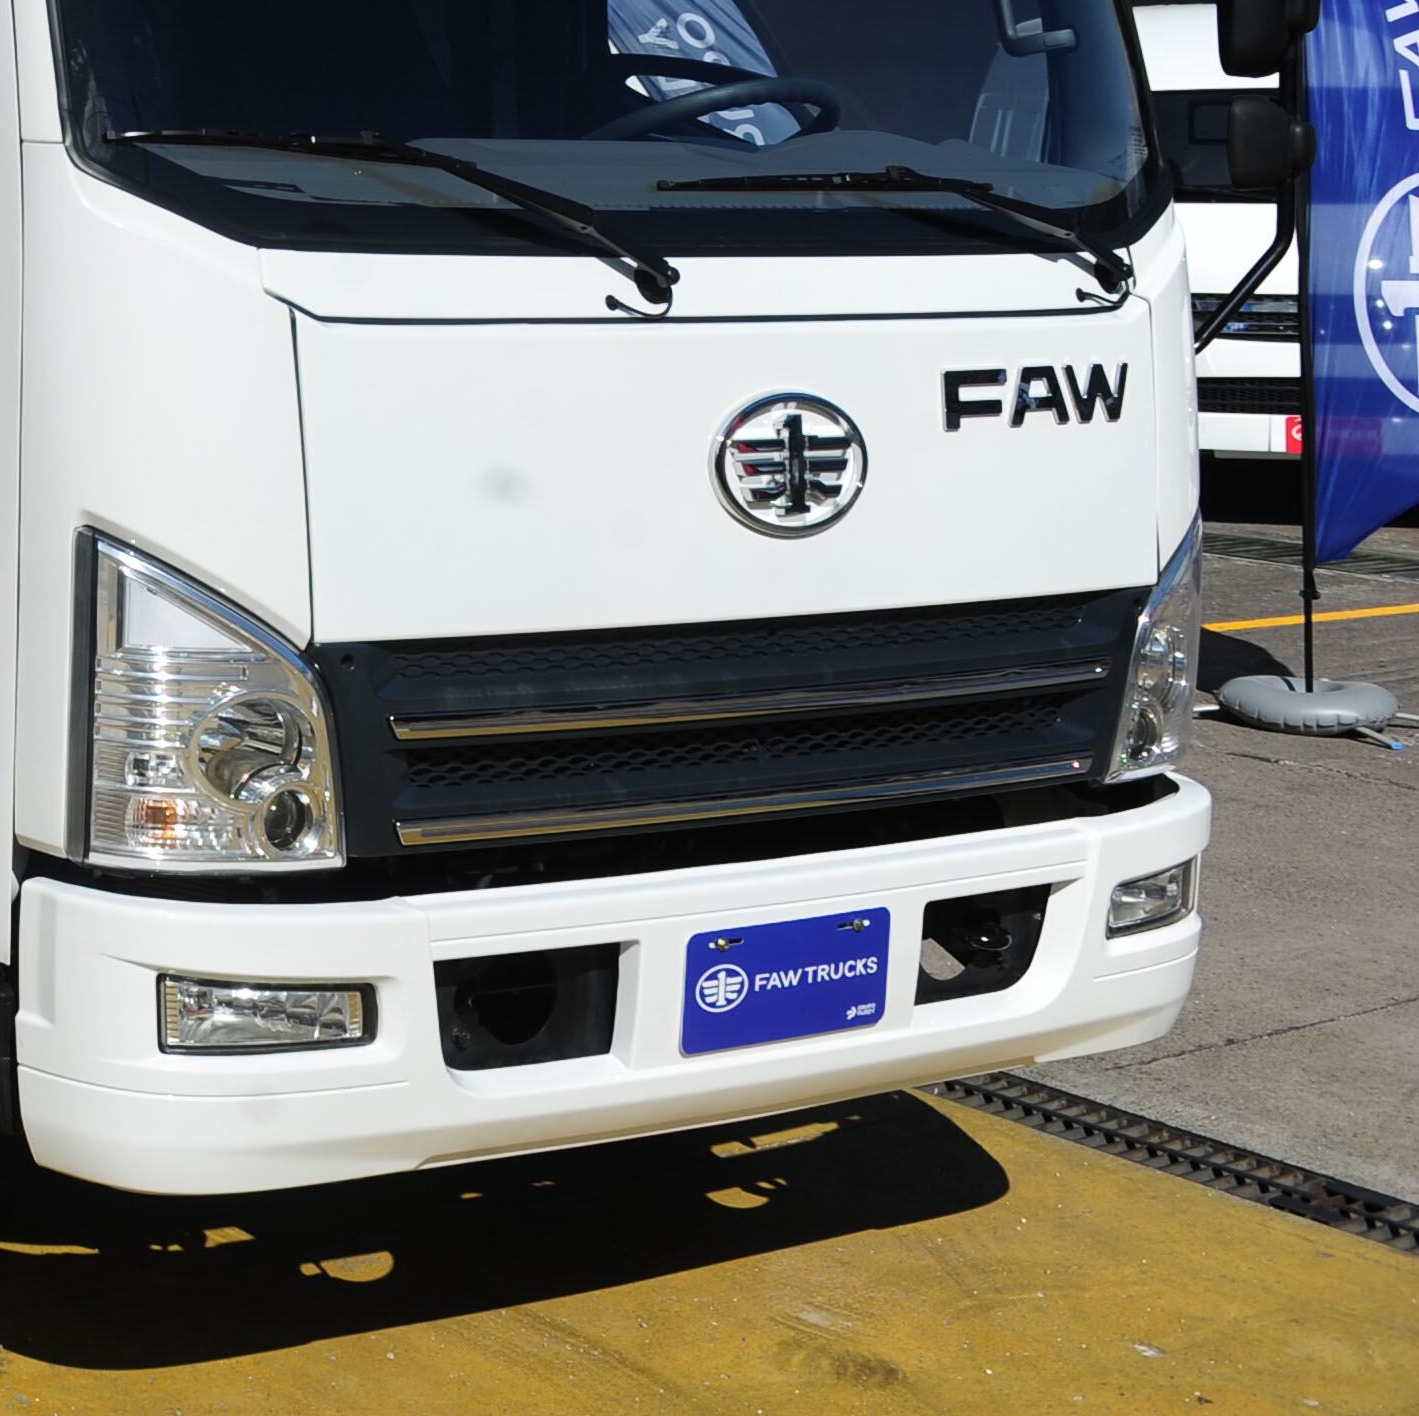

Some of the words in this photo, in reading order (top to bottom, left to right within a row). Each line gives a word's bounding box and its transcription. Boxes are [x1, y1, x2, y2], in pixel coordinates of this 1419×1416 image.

[940, 359, 1129, 433] FAW
[754, 967, 804, 992] FAW
[804, 956, 879, 984] TRUCKS
